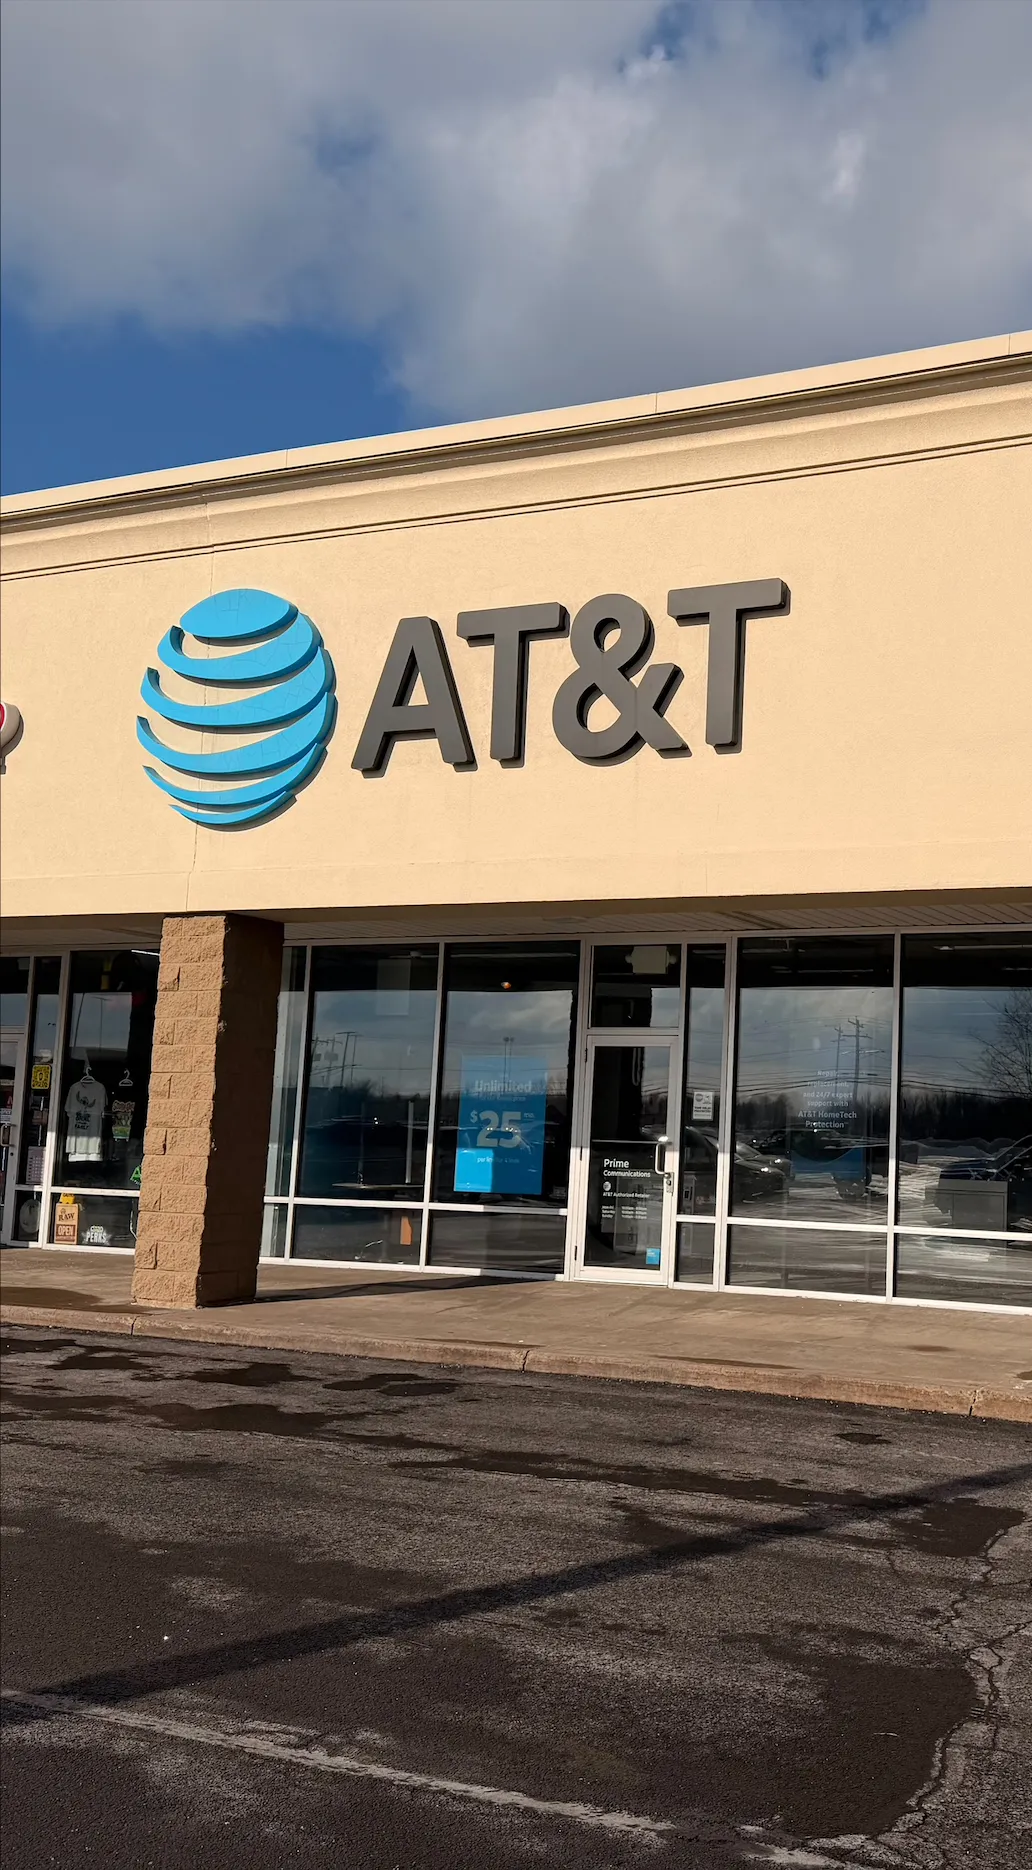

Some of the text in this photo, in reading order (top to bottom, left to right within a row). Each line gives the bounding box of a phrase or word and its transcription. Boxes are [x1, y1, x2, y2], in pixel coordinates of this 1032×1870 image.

[352, 578, 790, 777] AT&T
[475, 1080, 532, 1092] Unlimited
[604, 1159, 629, 1168] Prime
[59, 1212, 75, 1221] RAW
[58, 1225, 74, 1236] OPEN
[86, 1231, 106, 1243] PERKS
